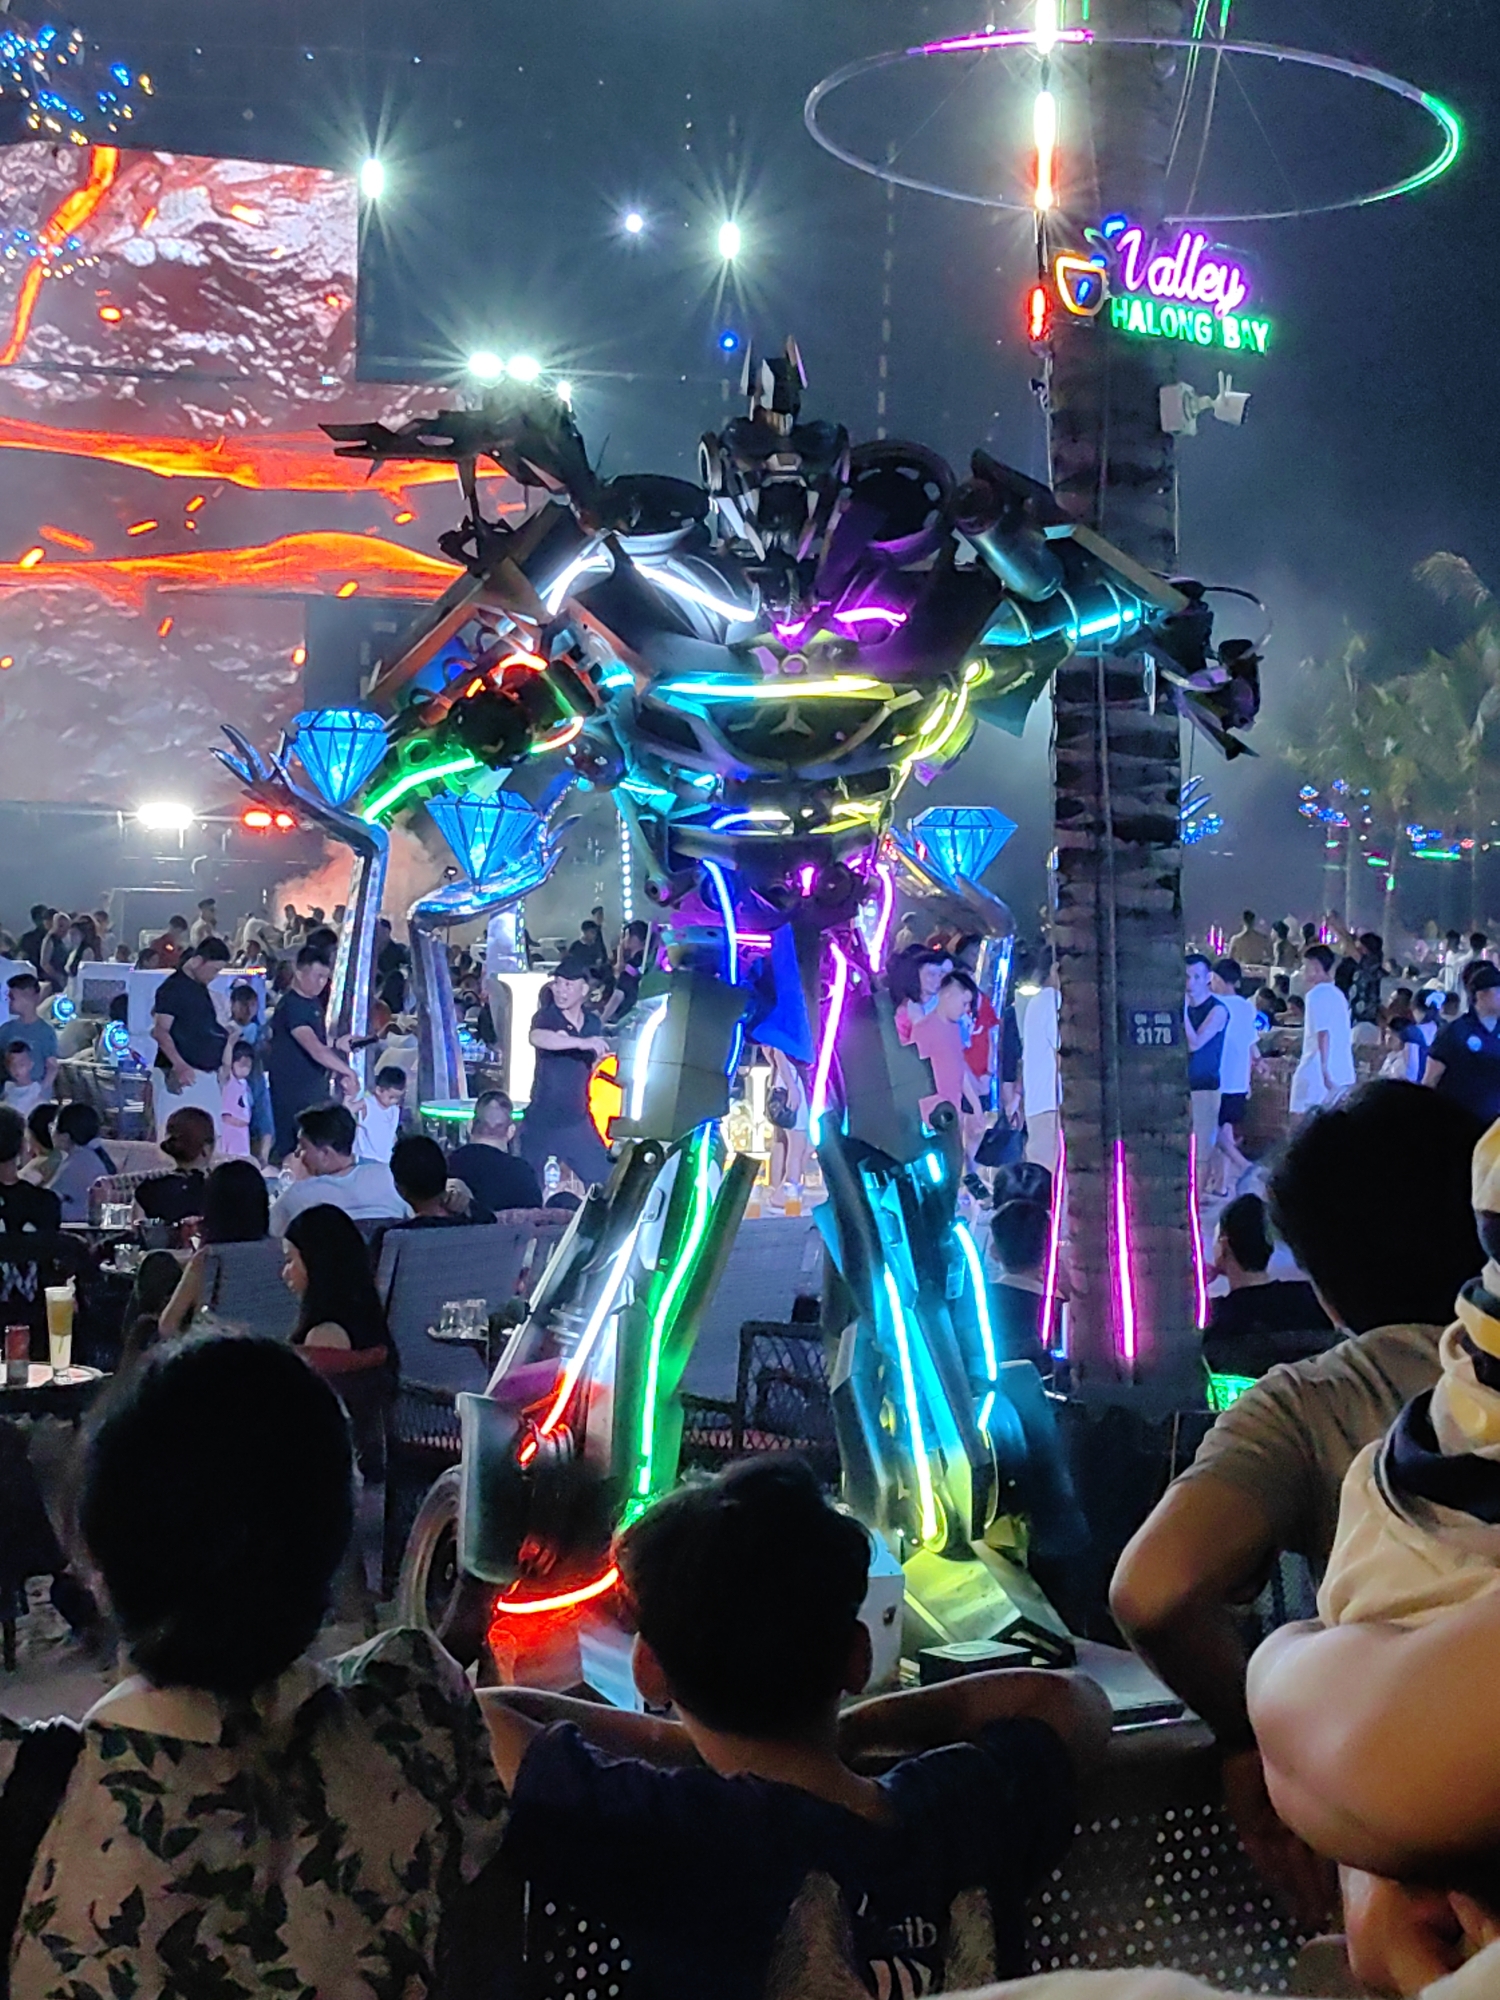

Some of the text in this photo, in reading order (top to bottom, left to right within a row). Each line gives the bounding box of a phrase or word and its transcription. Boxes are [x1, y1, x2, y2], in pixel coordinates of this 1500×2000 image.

[1115, 228, 1246, 319] Valley
[1111, 297, 1269, 352] HALONG BAY
